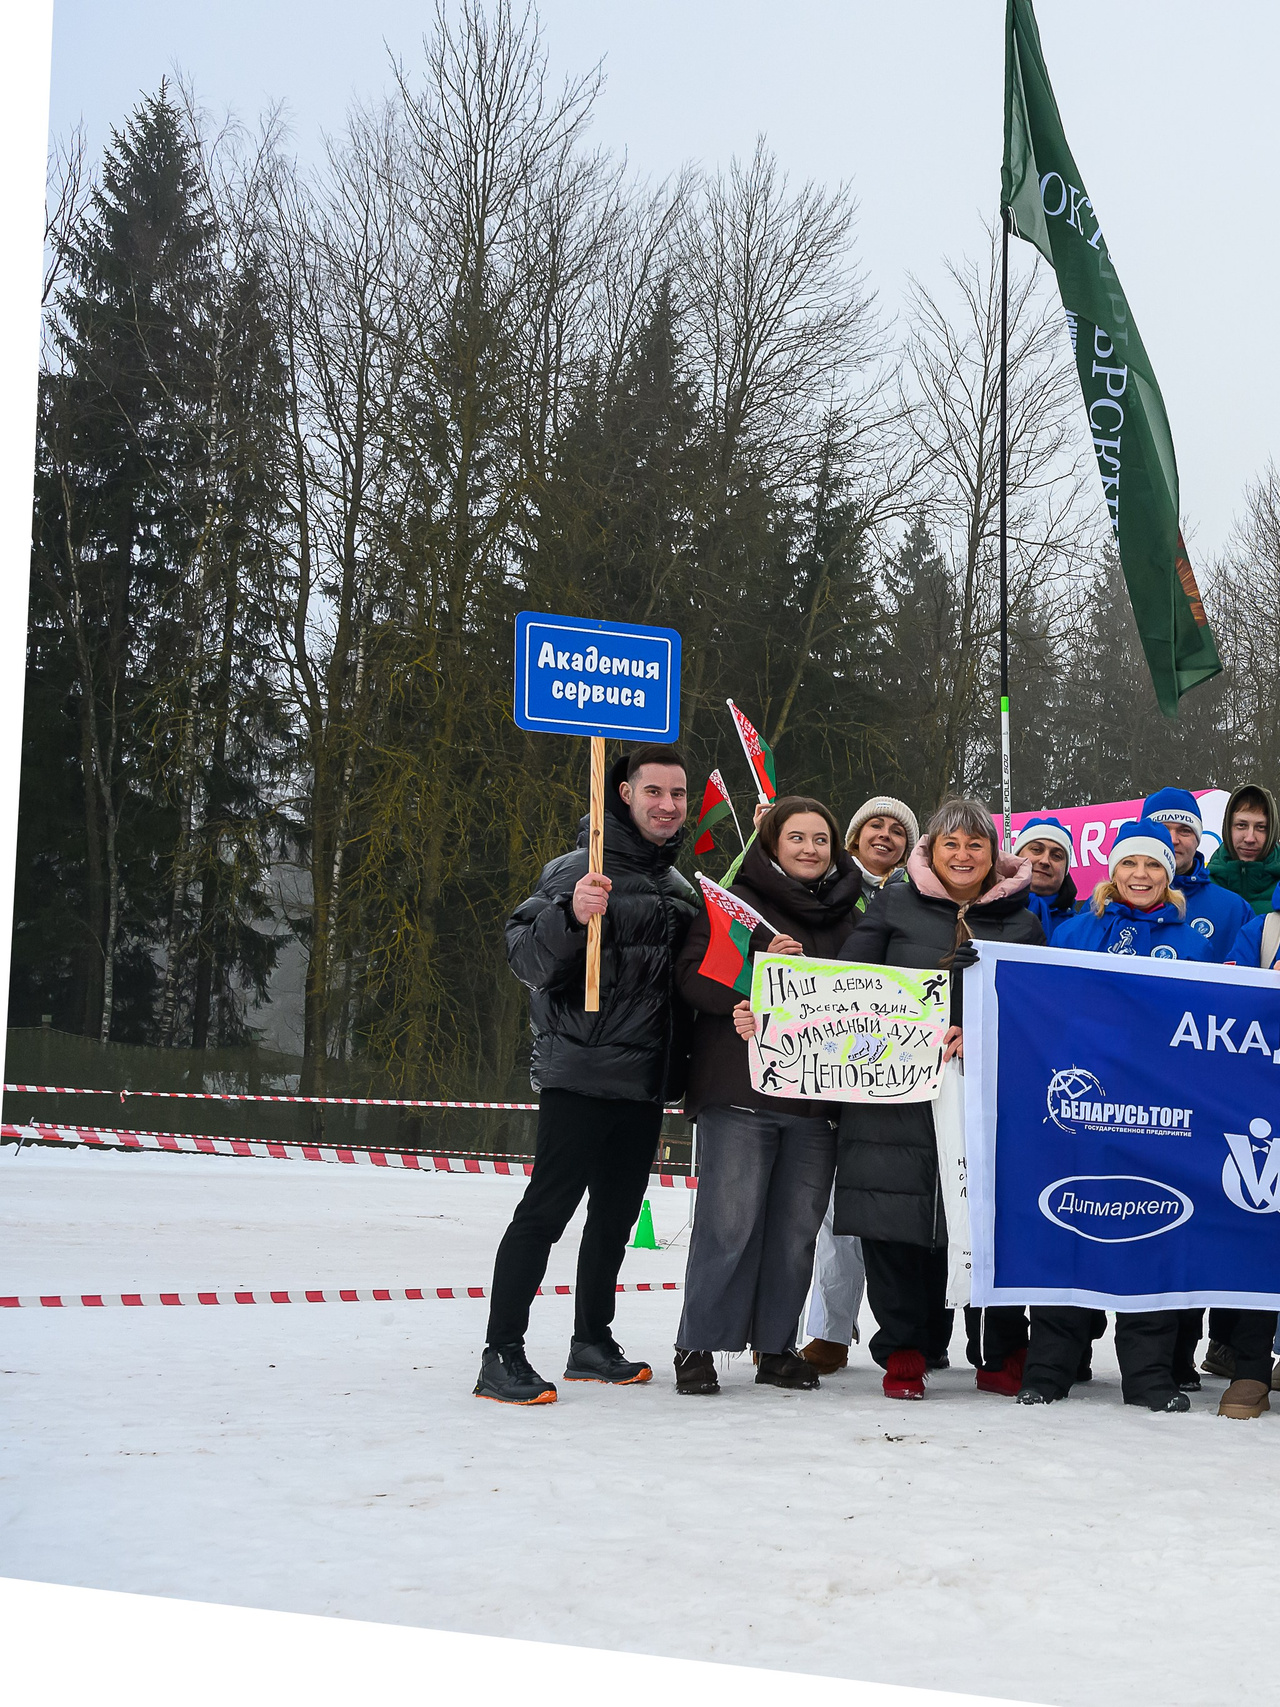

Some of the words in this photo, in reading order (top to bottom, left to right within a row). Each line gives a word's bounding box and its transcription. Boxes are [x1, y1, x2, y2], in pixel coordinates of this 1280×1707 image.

[538, 641, 660, 681] Академия
[552, 680, 646, 709] сервиса
[1004, 806, 1012, 839] STRIKE
[1060, 1099, 1193, 1128] БЕЛАРУСЬТОРГ
[1084, 1124, 1145, 1134] ГОСУДАРСТВЕННОЕ
[1146, 1128, 1192, 1137] ПРЕДПРИЯТИЕ
[1057, 1192, 1180, 1220] Дипмаркет
